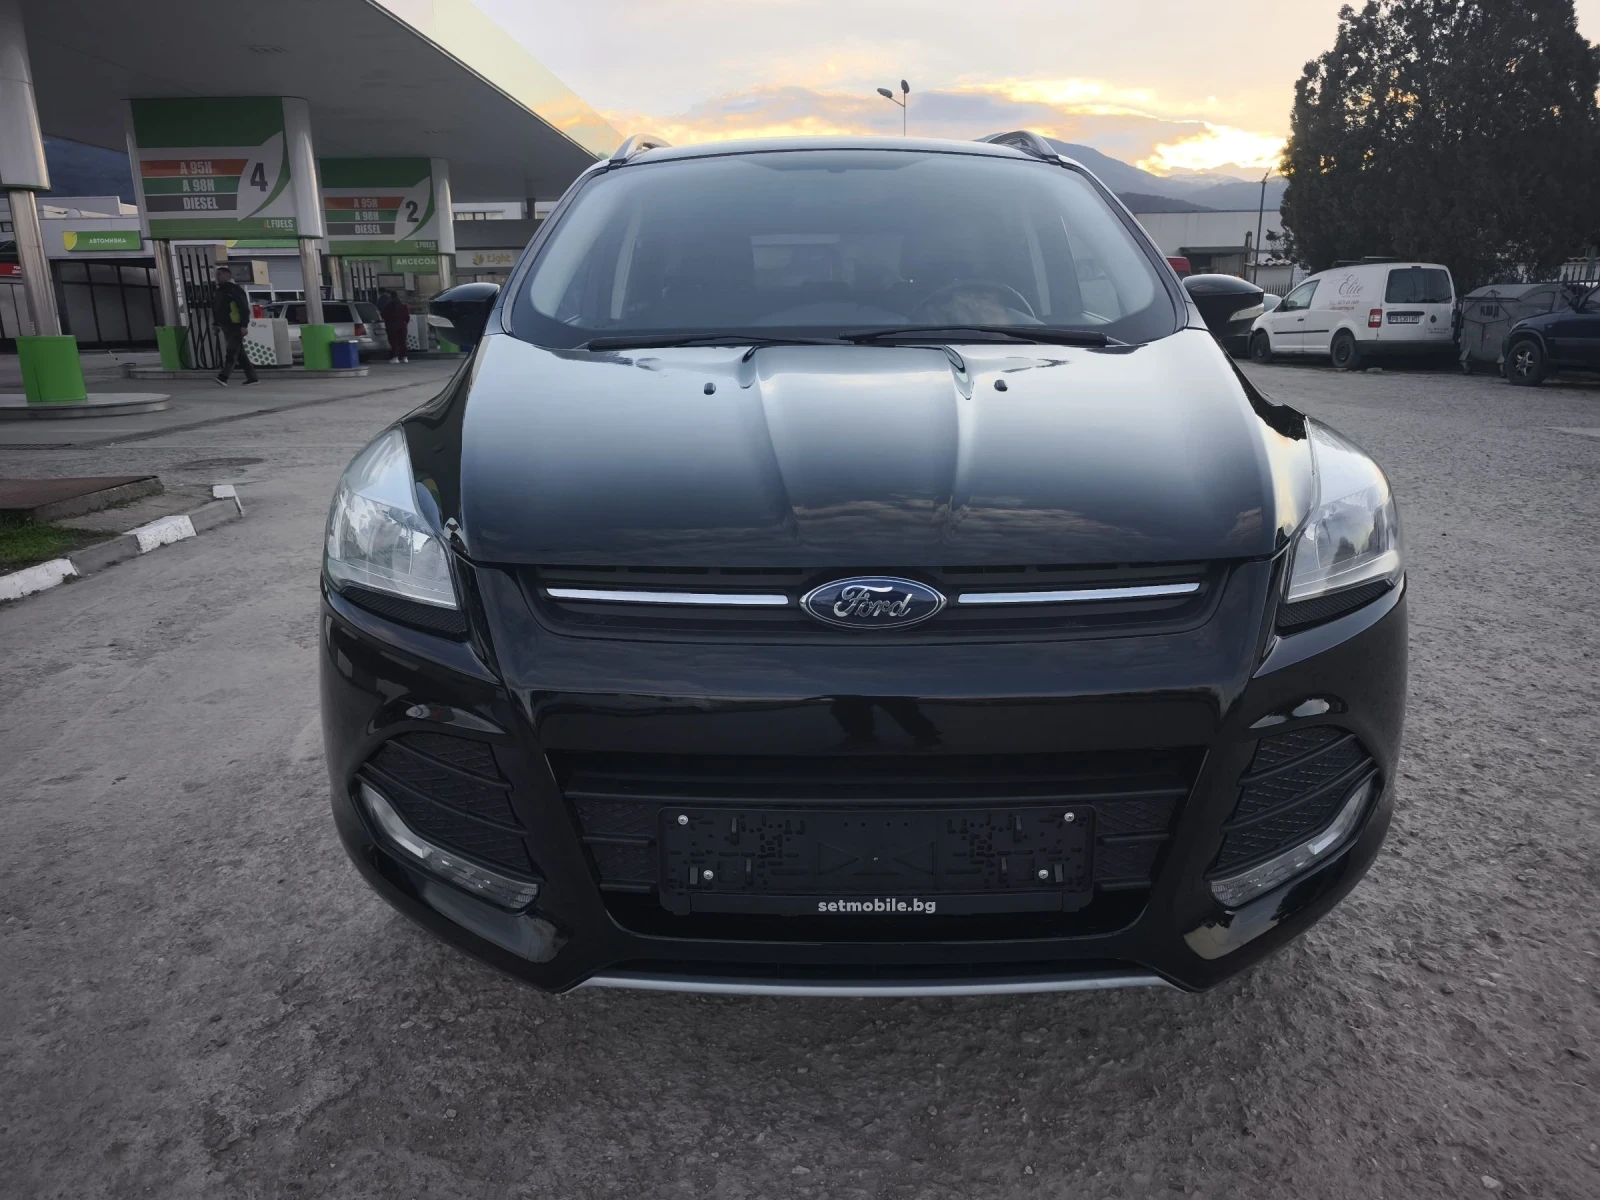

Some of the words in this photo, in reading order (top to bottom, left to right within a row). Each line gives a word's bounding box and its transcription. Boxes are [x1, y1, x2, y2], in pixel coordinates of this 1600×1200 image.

[181, 162, 188, 174] A
[250, 163, 268, 192] 4
[182, 180, 190, 192] A
[183, 197, 218, 210] DIESEL
[353, 198, 360, 208] A
[355, 211, 361, 221] A
[405, 200, 420, 223] 2
[355, 224, 381, 234] DIESEL
[833, 585, 913, 617] Ford
[818, 898, 936, 914] setmobile.bg
